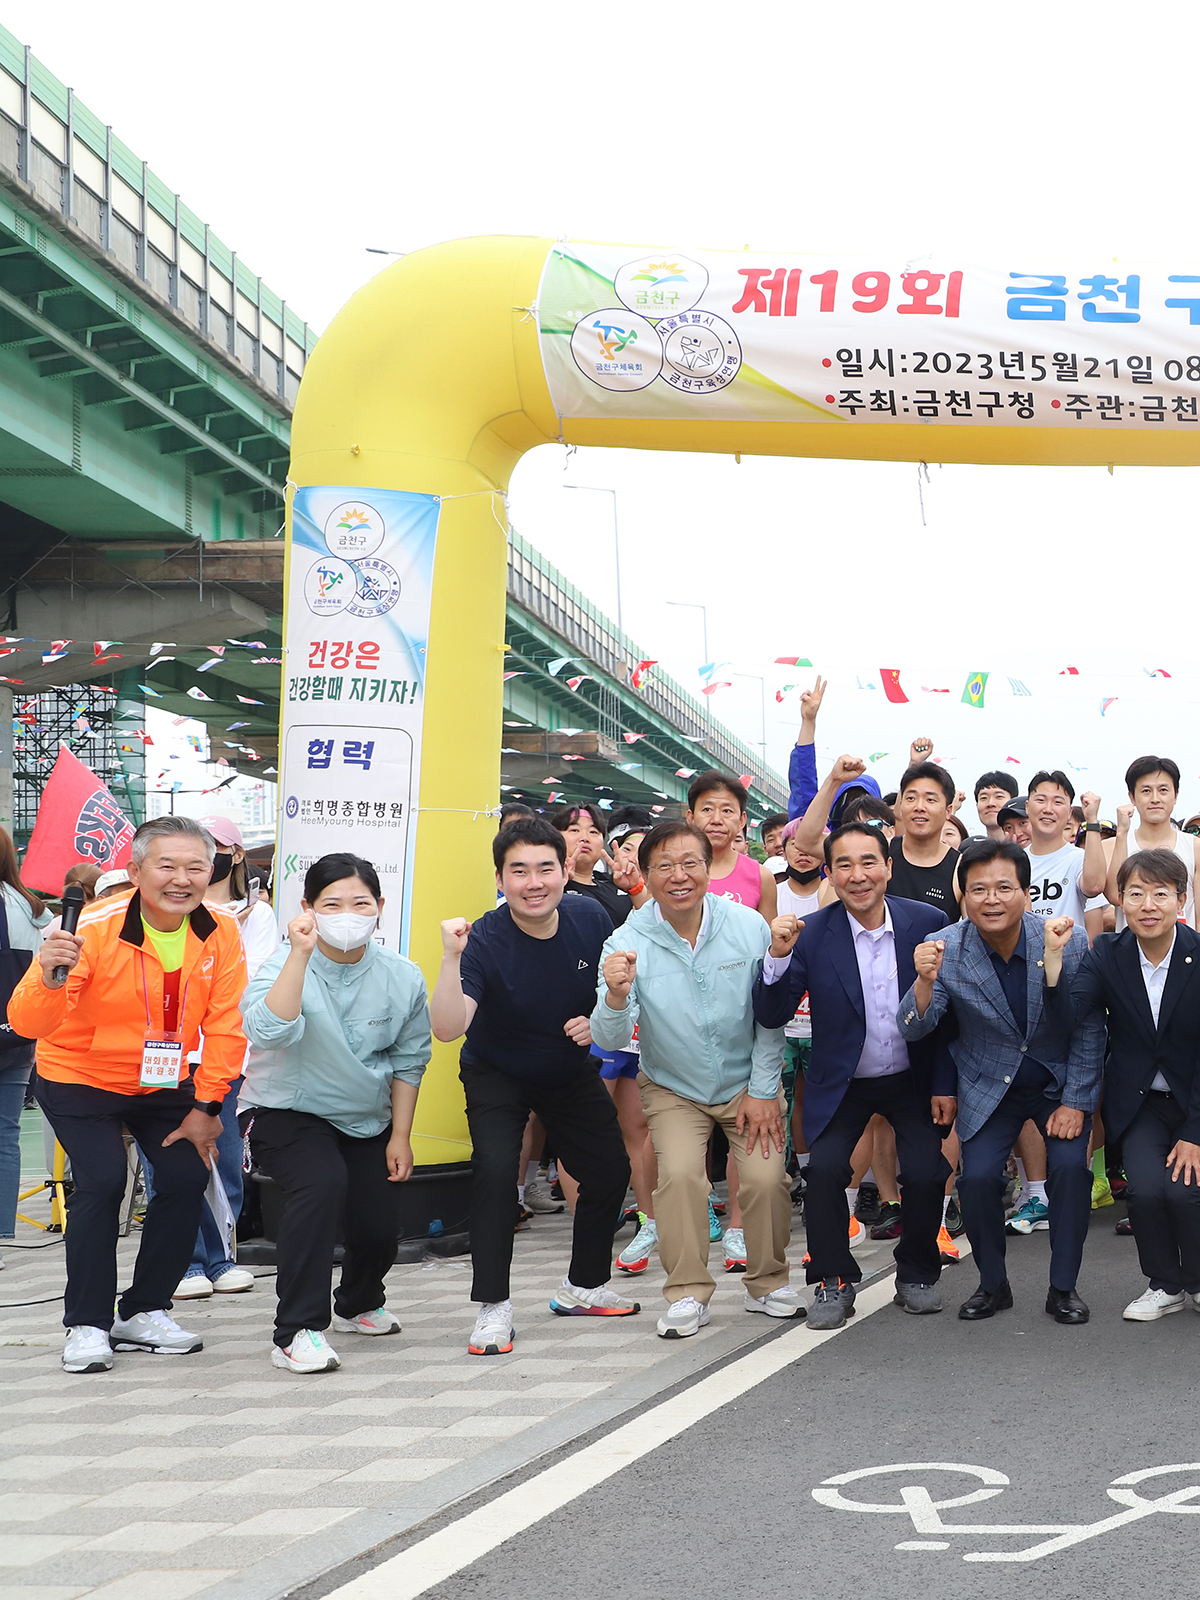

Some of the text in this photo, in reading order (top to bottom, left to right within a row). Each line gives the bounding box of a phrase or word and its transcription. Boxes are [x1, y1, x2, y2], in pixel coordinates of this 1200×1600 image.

[634, 291, 680, 305] 금천구
[732, 268, 963, 318] 제19회
[1005, 272, 1141, 323] 금천
[657, 313, 715, 337] 서울특별시
[595, 363, 643, 371] 금천구체육회
[668, 355, 739, 390] 금천구육상연맹
[836, 348, 1153, 384] 일시:2023년5월21일
[838, 389, 1035, 419] 주최:금천구청
[338, 535, 367, 546] 금천구
[308, 640, 380, 670] 건강은
[289, 675, 418, 705] 건강할때 지키자!
[313, 799, 403, 819] 희명종합병원
[301, 816, 400, 828] HeeMyoung Hospital
[1030, 878, 1063, 902] eb
[1032, 907, 1053, 916] ers
[717, 961, 747, 971] Discovery
[145, 1067, 176, 1076] 위원장
